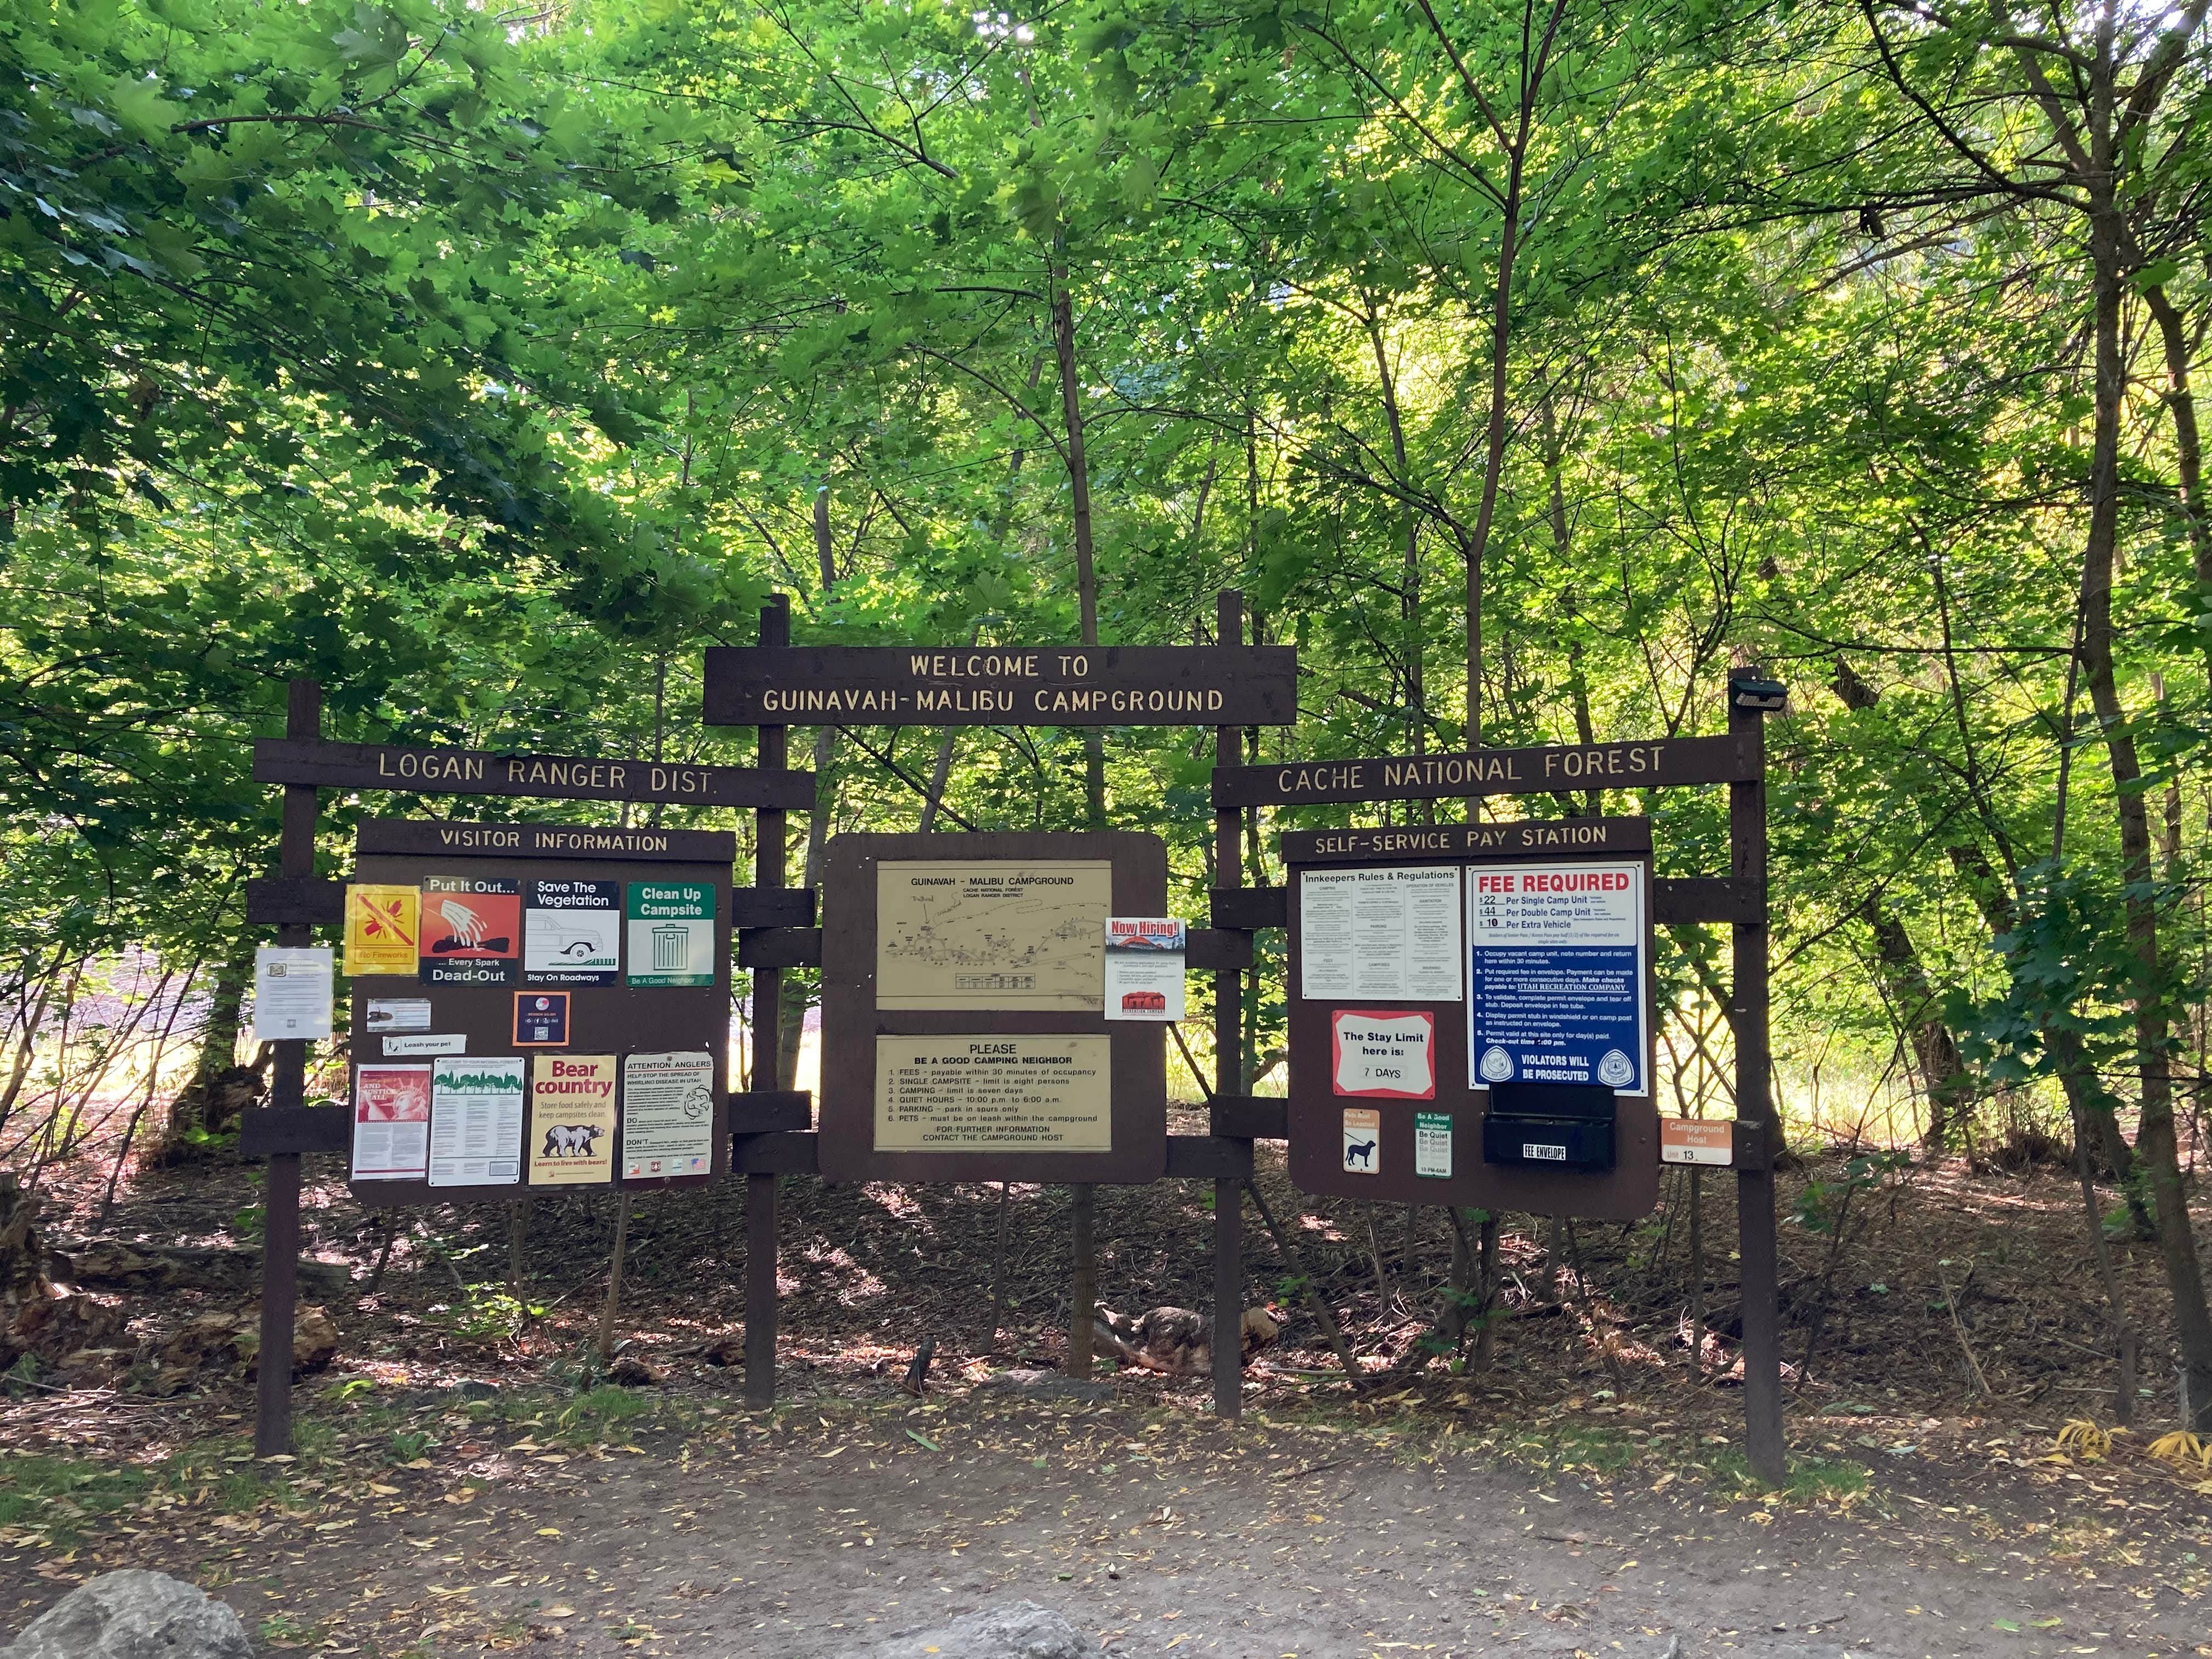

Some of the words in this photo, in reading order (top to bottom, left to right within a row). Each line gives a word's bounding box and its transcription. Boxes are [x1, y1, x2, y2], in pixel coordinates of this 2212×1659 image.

[911, 655, 1037, 676] WELCOME
[1060, 655, 1087, 676] TO
[764, 690, 1012, 710] GUINAVAH-MALIBU
[1035, 690, 1222, 710] CAMPGROUND
[380, 753, 482, 779] LOGAN
[509, 761, 624, 787] RANGER
[651, 763, 715, 793] DIST.
[1279, 766, 1364, 791] CACHE
[1385, 758, 1521, 785] NATIONAL
[1545, 747, 1662, 776] FOREST
[441, 830, 518, 846] VISITOR
[535, 833, 666, 850] INFORMATION
[1316, 833, 1448, 853] SELF-SERVICE
[1467, 831, 1505, 847] PAY
[1522, 826, 1605, 845] STATION
[1306, 874, 1355, 883] Innkeepers
[1397, 871, 1454, 881] Regulations
[1479, 876, 1514, 892] FEE
[1523, 873, 1628, 891] REQUIRED
[430, 879, 454, 891] Put
[460, 878, 470, 891] It
[475, 880, 515, 894] Out...
[538, 881, 569, 892] Save
[573, 882, 596, 893] The
[538, 894, 608, 907] Vegetation
[642, 888, 679, 899] Clean
[684, 888, 701, 901] Up
[1521, 896, 1544, 906] Single
[1547, 896, 1568, 905] Camp
[641, 904, 702, 917] Campsite
[1550, 908, 1572, 917] Camp
[1111, 921, 1137, 937] Now
[1139, 921, 1179, 937] Hiring!
[449, 958, 473, 967] Every
[476, 958, 499, 967] Spark
[433, 969, 504, 980] Dead-Out
[527, 974, 544, 982] Stay
[667, 977, 695, 985] Neighbor
[1344, 1031, 1363, 1040] The
[1368, 1032, 1391, 1042] Stay
[1396, 1033, 1423, 1042] Limit
[970, 1044, 1015, 1053] PLEASE
[1362, 1046, 1387, 1055] here
[1391, 1047, 1403, 1055] is:
[1521, 1054, 1566, 1065] VIOLATORS
[1569, 1056, 1589, 1066] WILL
[552, 1060, 597, 1076] Bear
[1365, 1068, 1369, 1076] 7
[1376, 1068, 1401, 1078] DAYS
[1522, 1069, 1533, 1079] BE
[1536, 1069, 1588, 1081] PROSECUTED
[535, 1079, 612, 1097] country
[575, 1101, 592, 1109] safely
[1670, 1122, 1724, 1133] Campground
[1686, 1135, 1706, 1144] Host
[1525, 1146, 1534, 1156] FEE
[1537, 1146, 1565, 1159] ENVELOPE
